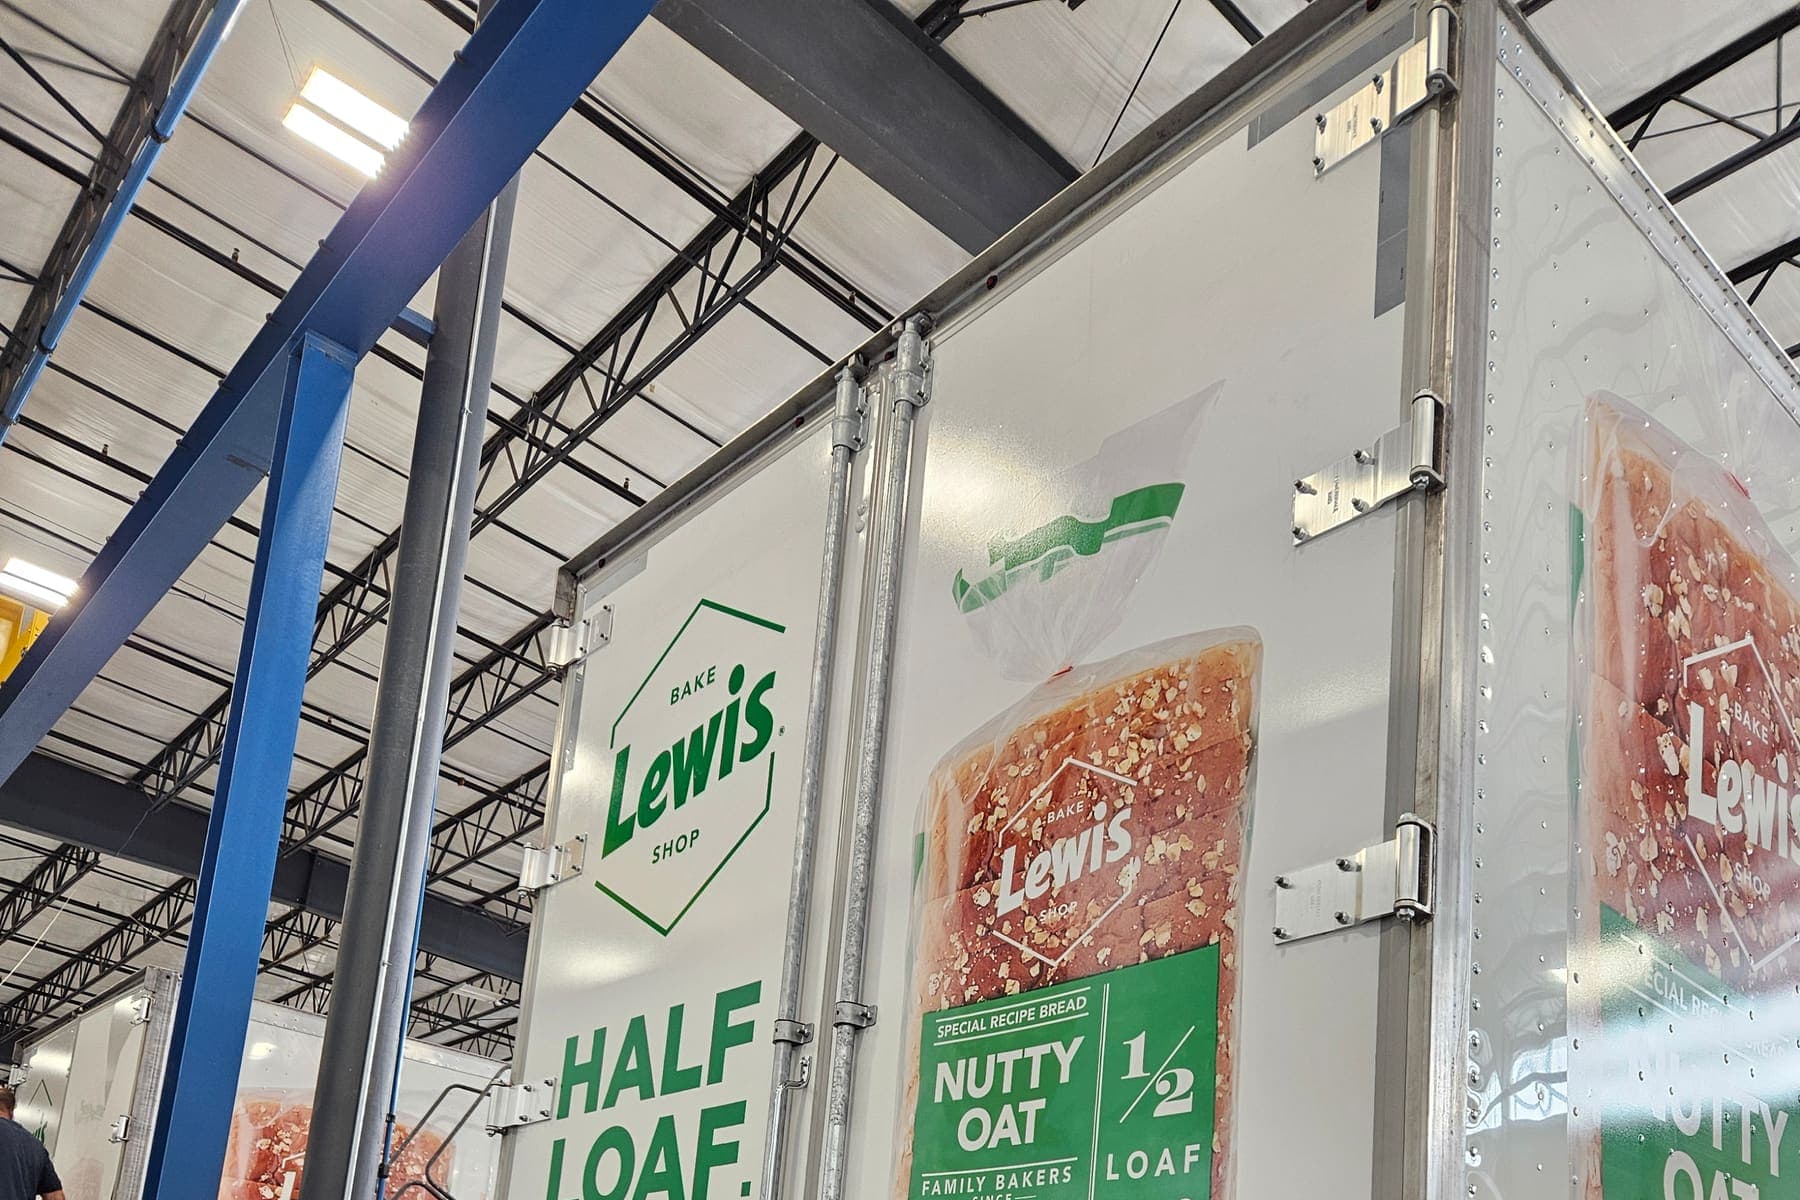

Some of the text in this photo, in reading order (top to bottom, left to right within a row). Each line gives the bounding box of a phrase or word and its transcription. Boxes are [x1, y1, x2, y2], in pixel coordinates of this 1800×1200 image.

[670, 665, 716, 705] BAKE
[1734, 701, 1769, 745] BAKE
[601, 663, 777, 860] Lewis
[1047, 800, 1084, 824] BAKE
[651, 829, 700, 864] SHOP
[996, 801, 1132, 917] Lewis
[1734, 862, 1771, 897] SHOP
[1039, 901, 1078, 923] SHOP
[937, 996, 1087, 1039] SPECIAL RECIPE BREAD
[556, 980, 762, 1120] HALF
[934, 1035, 1085, 1103] NUTTY
[957, 1098, 1046, 1152] OAT
[922, 1166, 1072, 1196] FAMILY BAKERS
[1106, 1143, 1200, 1181] LOAF
